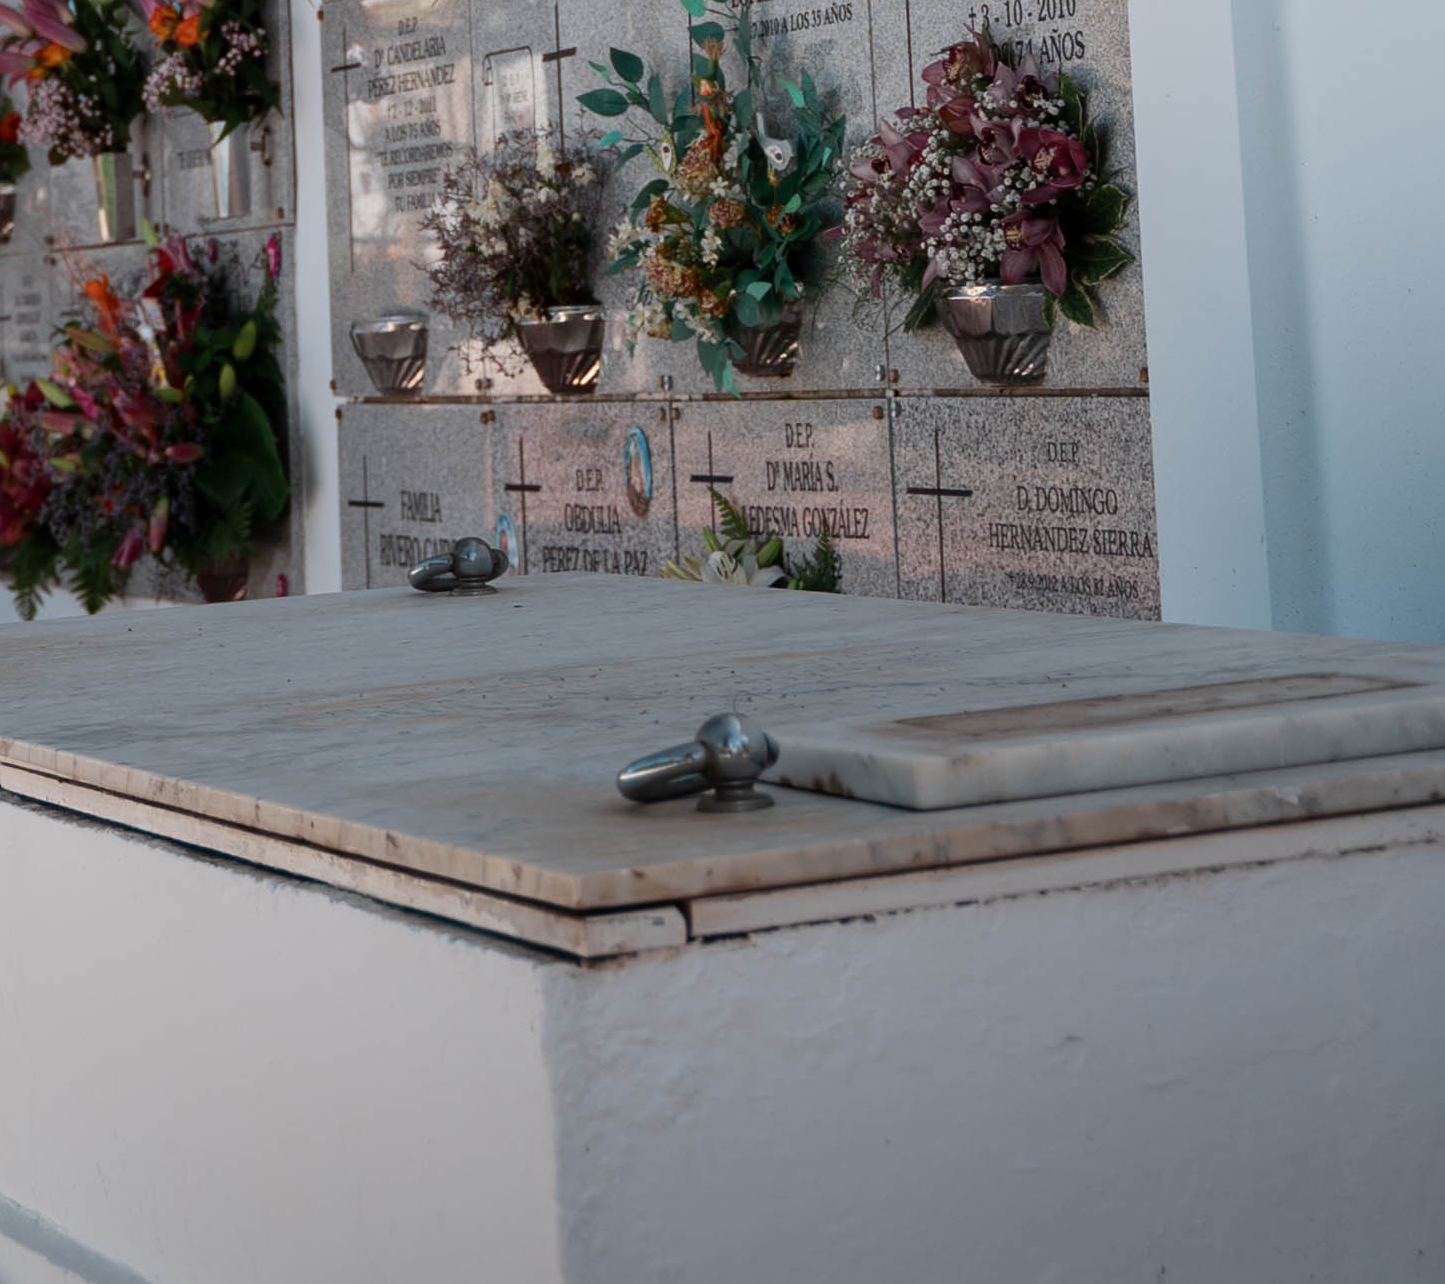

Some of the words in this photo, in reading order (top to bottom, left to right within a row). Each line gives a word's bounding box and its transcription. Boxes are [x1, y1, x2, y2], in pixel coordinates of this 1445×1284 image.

[790, 10, 811, 32] LOS
[823, 1, 853, 26] AÑOS
[387, 35, 447, 67] CANDELARIA
[1039, 28, 1086, 65] AÑOS
[783, 452, 824, 492] MARÍA
[1035, 485, 1119, 516] DOMINGO
[563, 503, 622, 534] OBDULIA
[802, 498, 871, 540] GONZÁLEZ
[1092, 528, 1154, 558] SIERRA
